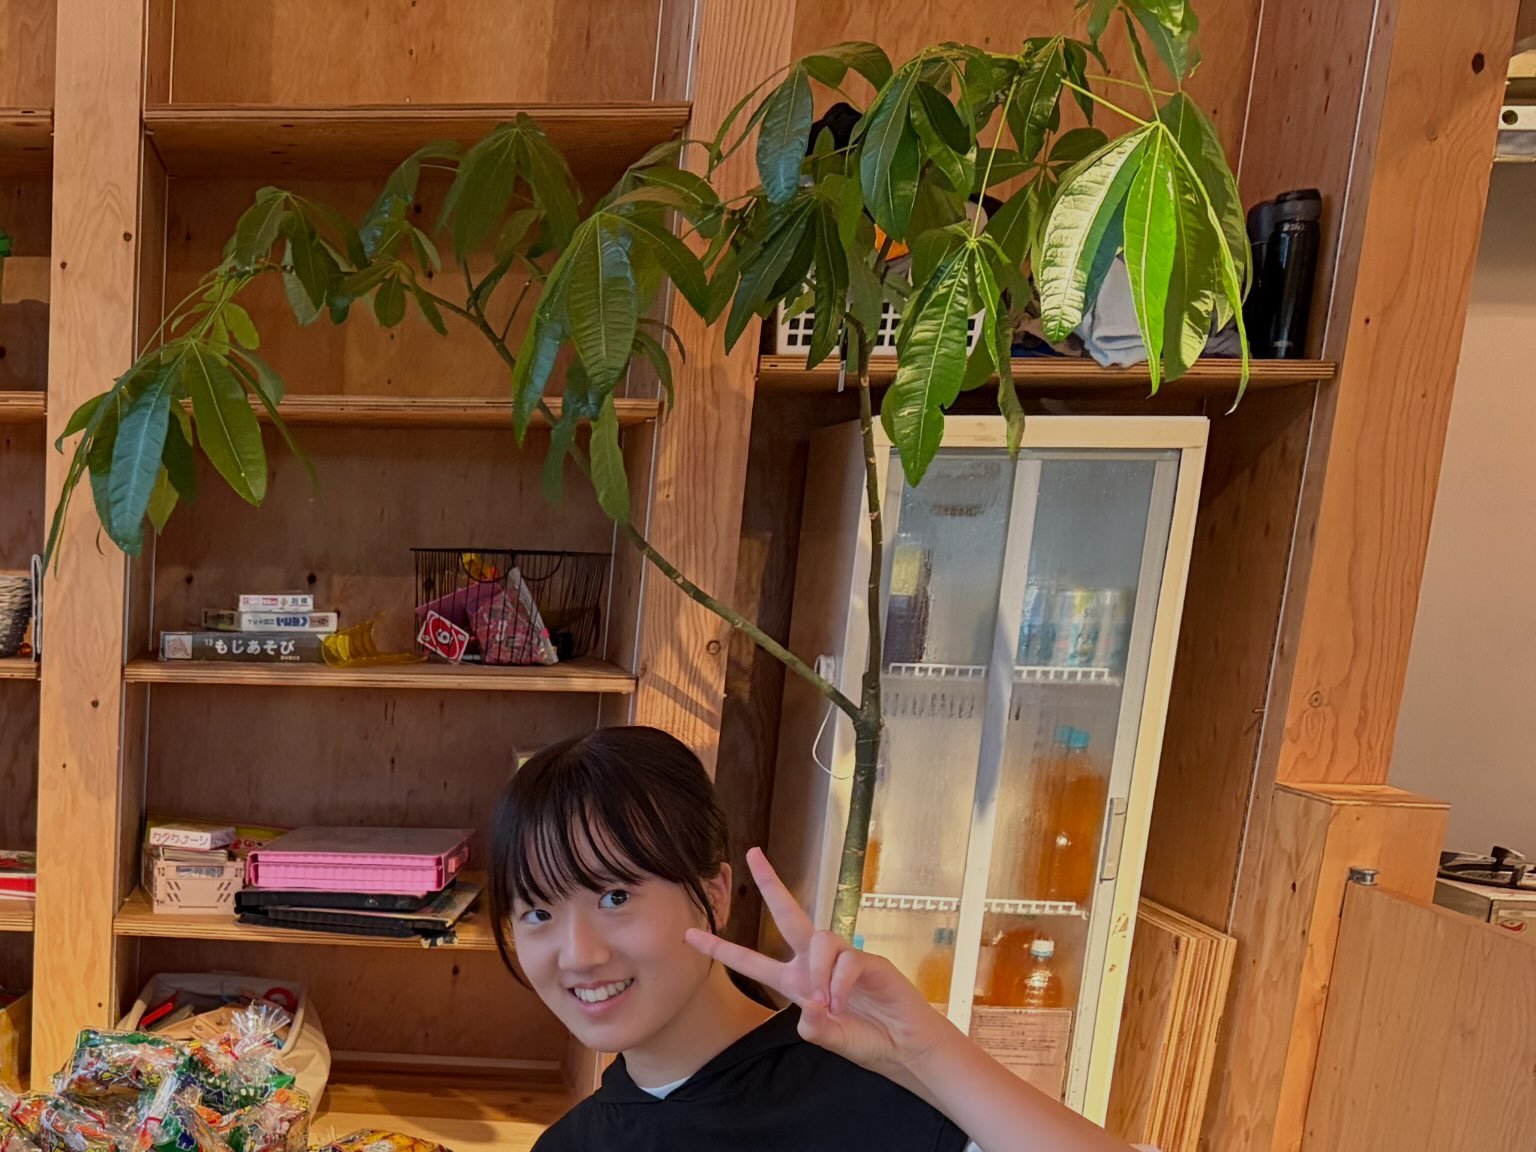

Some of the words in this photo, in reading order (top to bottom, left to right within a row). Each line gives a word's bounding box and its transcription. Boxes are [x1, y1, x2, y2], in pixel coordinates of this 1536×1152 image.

[214, 639, 296, 656] もじあそび
